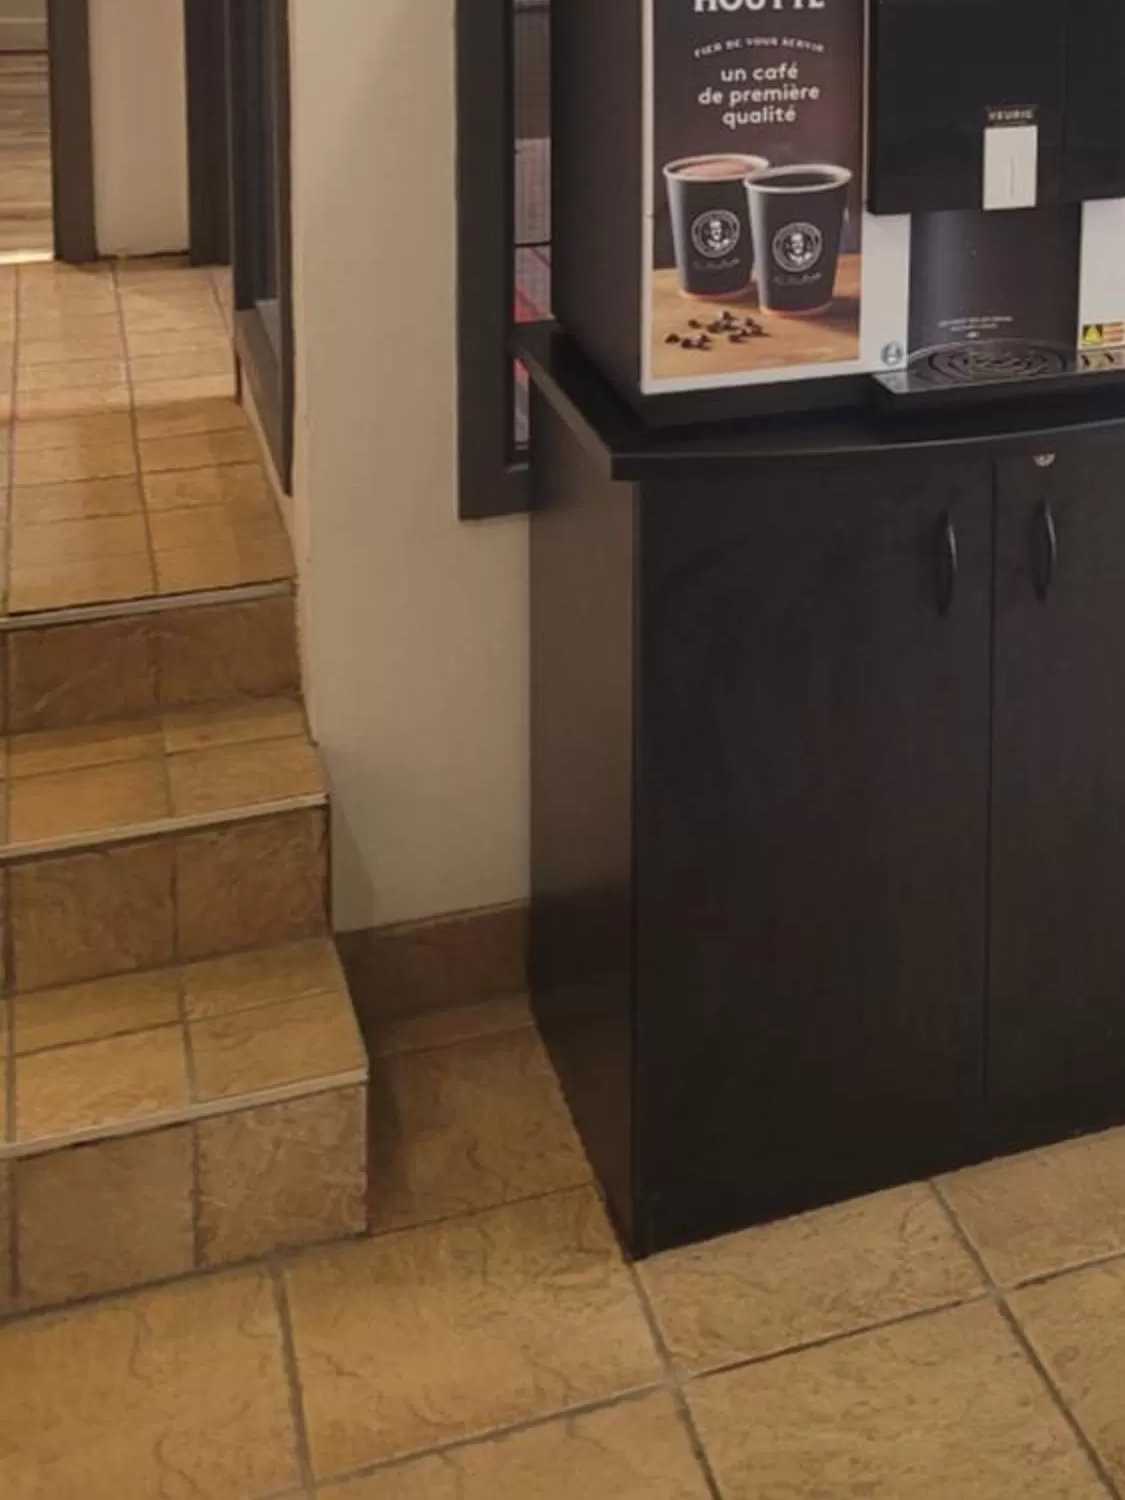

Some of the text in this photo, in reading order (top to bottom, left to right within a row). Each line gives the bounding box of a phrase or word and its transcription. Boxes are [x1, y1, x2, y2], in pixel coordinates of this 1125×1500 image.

[720, 61, 799, 82] un café
[698, 84, 821, 107] de première
[722, 104, 797, 130] qualité
